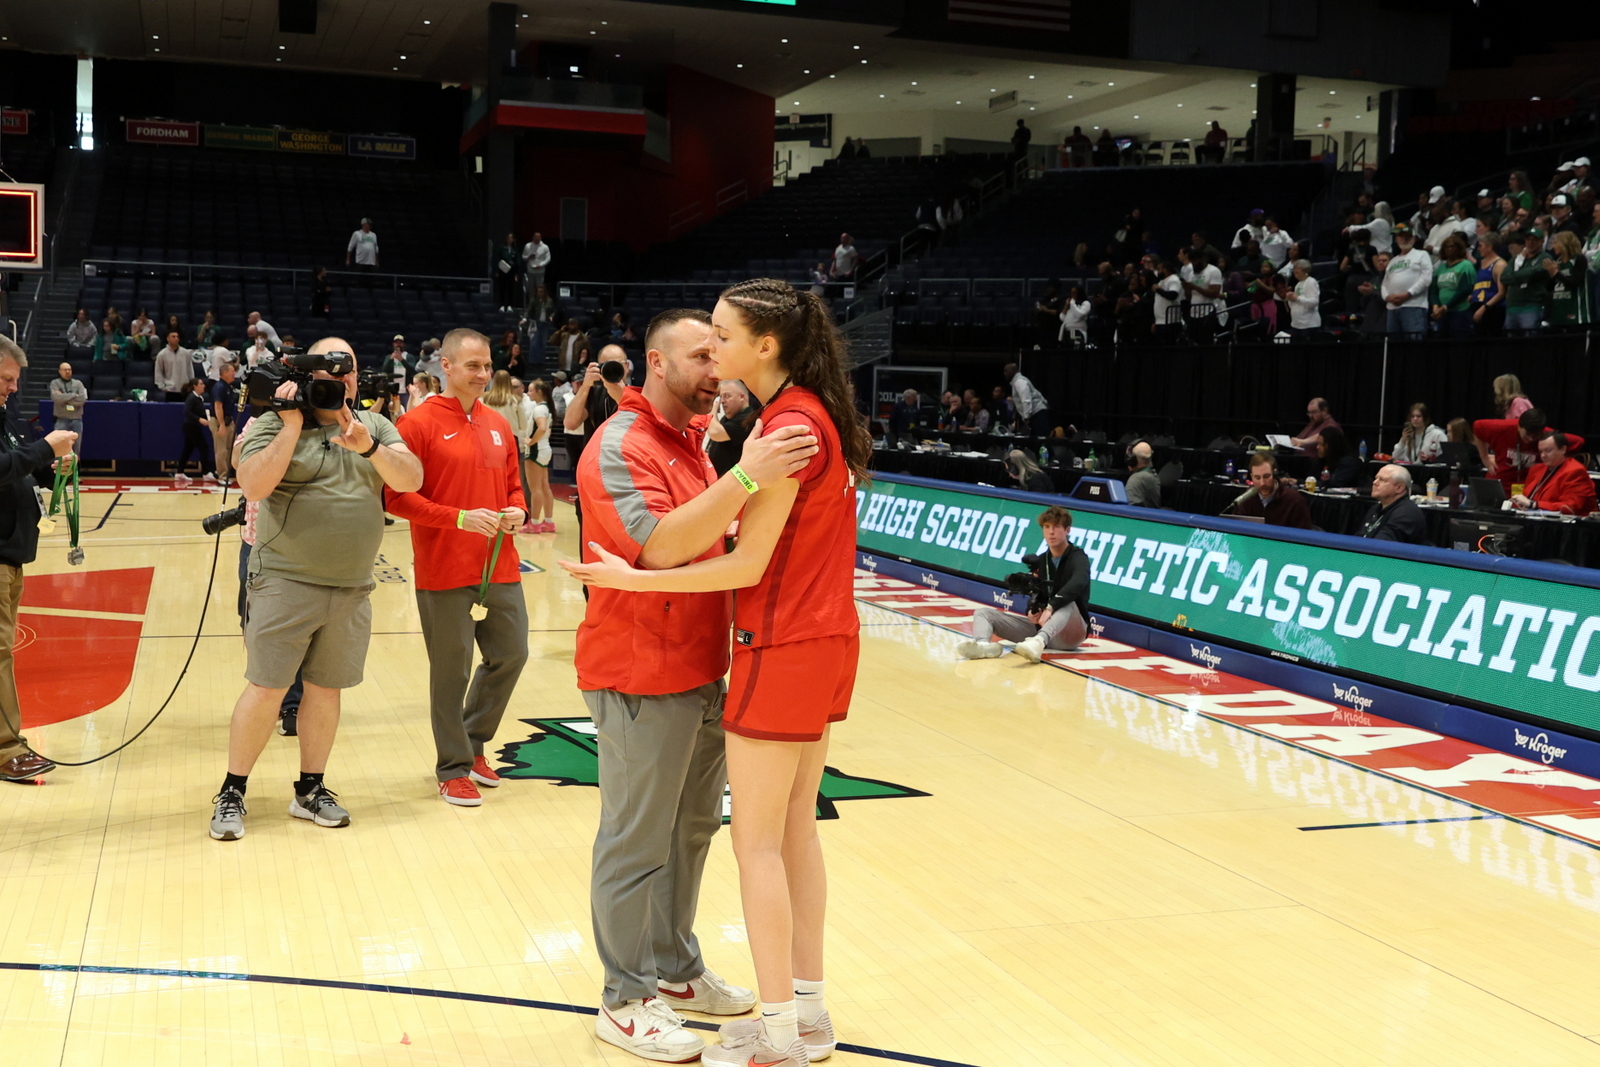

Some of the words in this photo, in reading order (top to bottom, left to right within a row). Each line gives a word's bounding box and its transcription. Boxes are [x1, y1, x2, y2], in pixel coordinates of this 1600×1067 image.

[136, 127, 189, 138] FORDHAM
[291, 133, 331, 144] GEORGE
[280, 141, 343, 152] WASHINGTON
[357, 141, 372, 151] LA
[375, 142, 407, 153] SALLE
[490, 430, 503, 446] B
[860, 493, 926, 539] HIGH
[920, 503, 1031, 563] SCHOOL
[1036, 526, 1229, 606] THLETIC
[1089, 616, 1105, 637] roger
[1199, 646, 1222, 668] Kroger
[1270, 651, 1300, 663] DAKTRONICS
[1344, 686, 1373, 712] Kroger
[1528, 732, 1567, 764] Kroger
